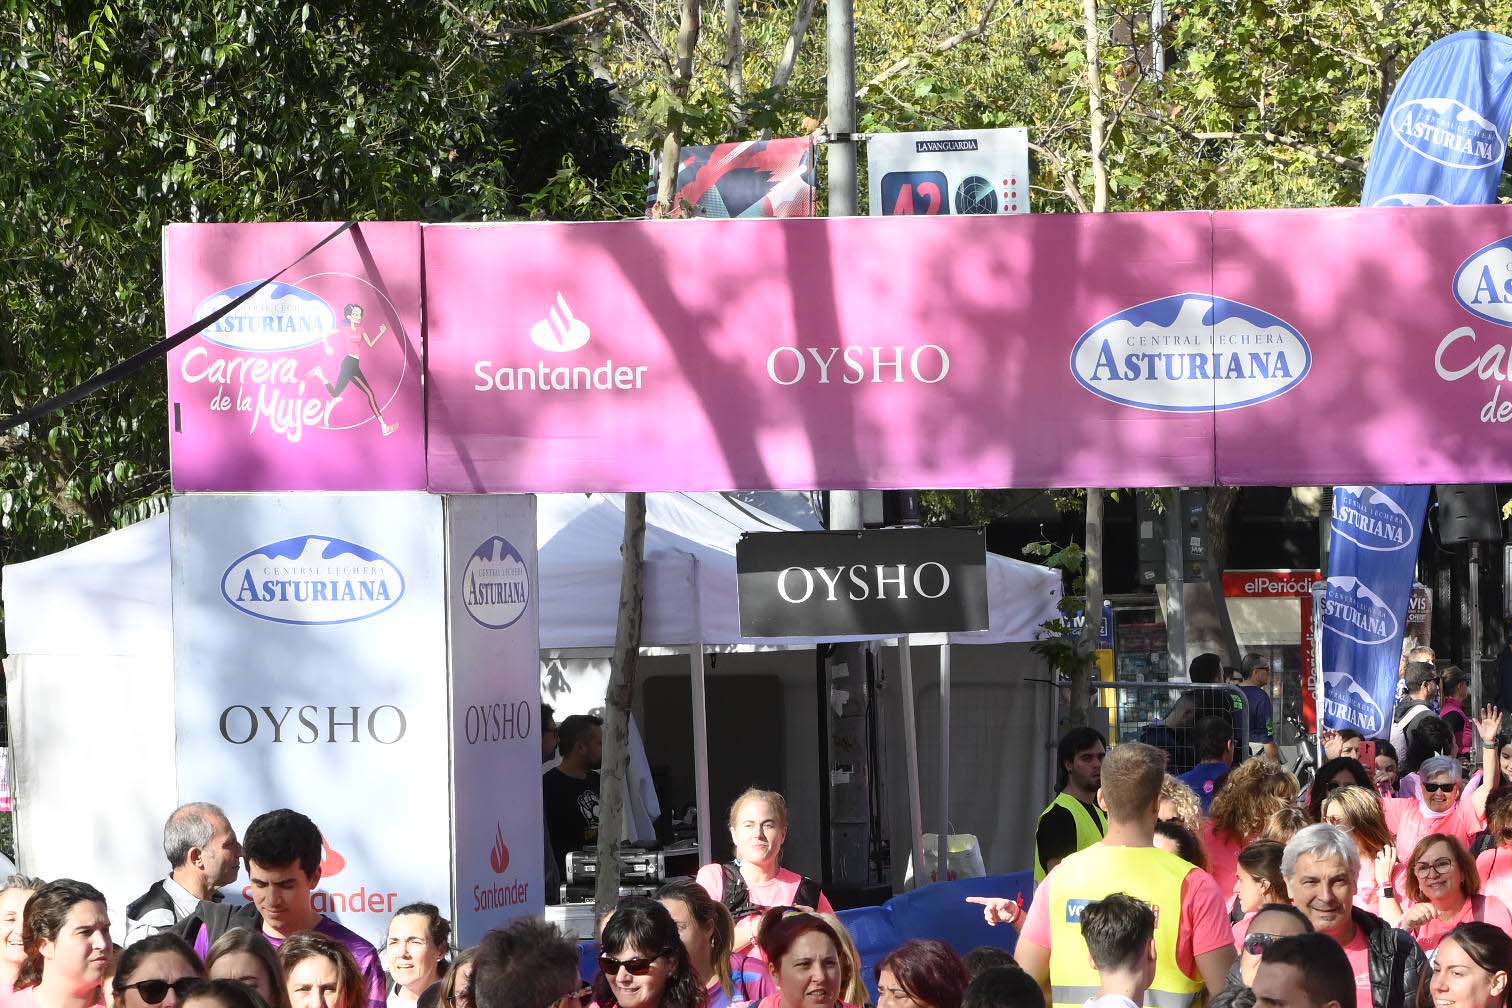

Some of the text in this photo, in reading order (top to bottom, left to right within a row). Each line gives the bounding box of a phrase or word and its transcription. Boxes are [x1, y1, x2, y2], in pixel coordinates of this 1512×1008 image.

[928, 140, 977, 150] VANGUARDIA
[1400, 111, 1492, 160] ASTURIANA
[1090, 338, 1292, 381] ASTURIANA
[1127, 333, 1284, 347] CENTRAL LECHERA
[180, 346, 299, 385] Carrera
[474, 359, 648, 391] Santander
[766, 344, 950, 385] OYSHO
[210, 383, 343, 442] de la Mujer
[238, 569, 391, 602] ASTURIANA
[264, 566, 385, 576] CENTRAL LECHERA
[777, 561, 950, 603] OYSHO
[1245, 578, 1316, 593] elPeriódi
[468, 578, 525, 605] ASTURIANA
[1326, 597, 1388, 638] STURIANA
[219, 705, 407, 744] OYSHO
[465, 700, 530, 744] OYSHO
[474, 881, 529, 912] Santander
